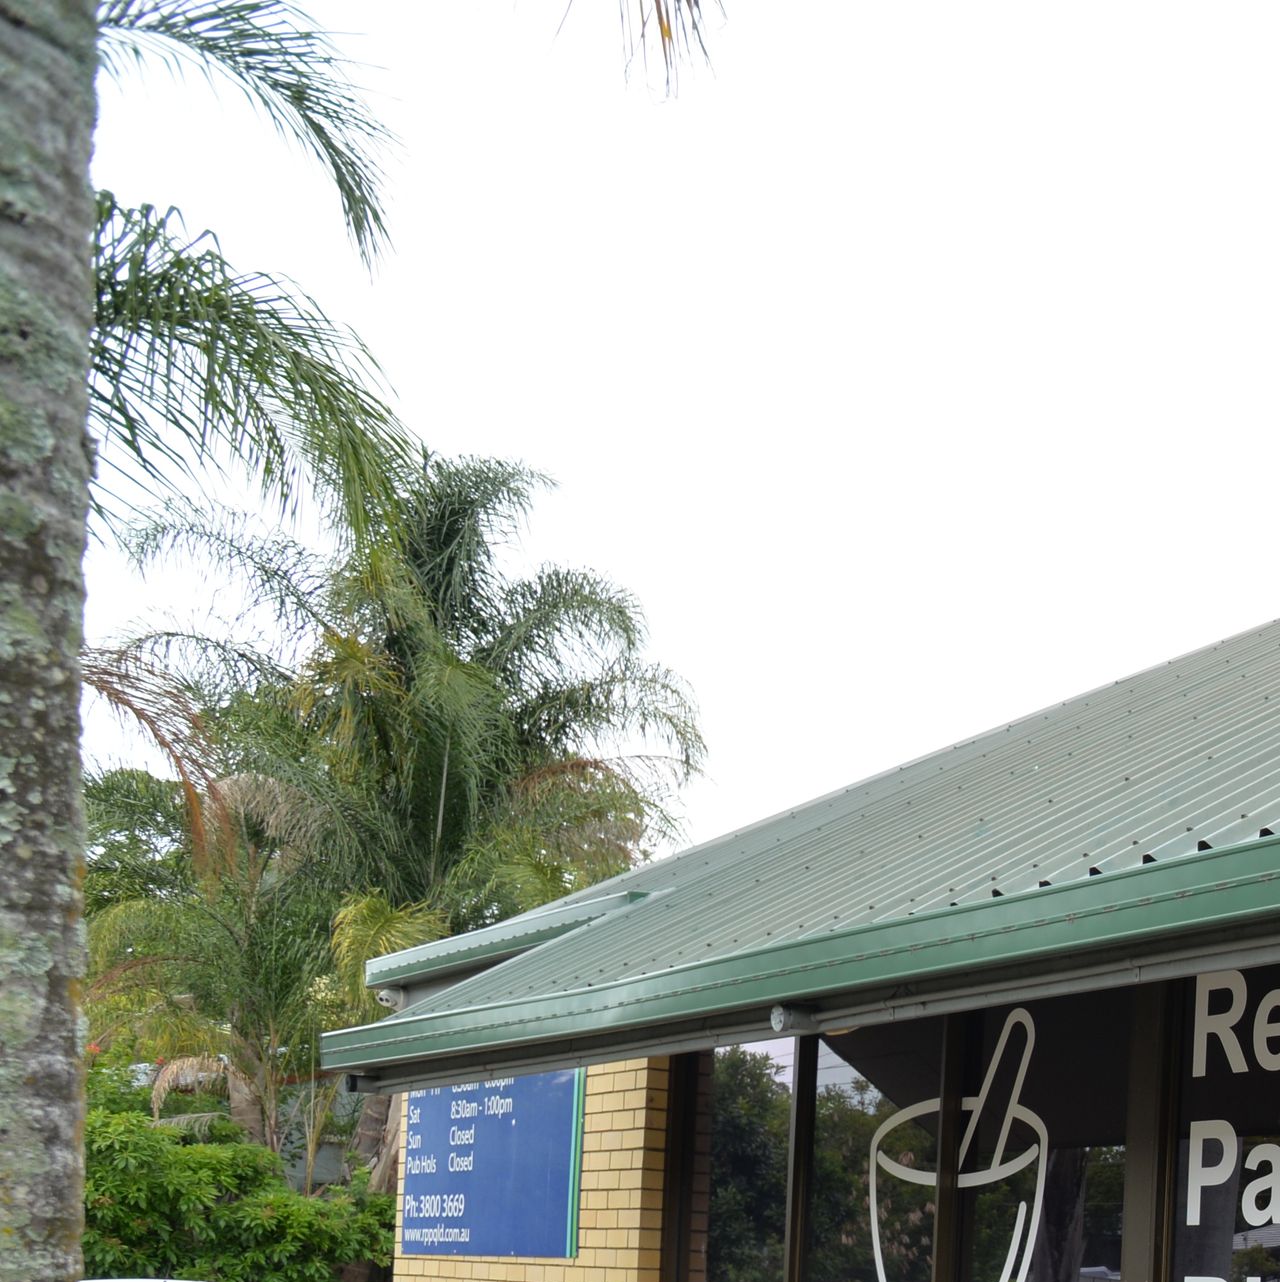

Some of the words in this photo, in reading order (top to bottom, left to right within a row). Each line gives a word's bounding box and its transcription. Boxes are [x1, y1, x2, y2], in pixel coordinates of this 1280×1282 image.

[409, 1106, 420, 1124] Sat
[451, 1099, 478, 1119] 8:30am
[484, 1095, 513, 1119] 1:00pm
[408, 1131, 421, 1149] Sun
[449, 1123, 475, 1146] Closed
[406, 1155, 421, 1175] Pub
[421, 1154, 437, 1174] Hols
[448, 1150, 474, 1172] Closed
[405, 1194, 418, 1218] Ph:
[419, 1194, 441, 1218] 3800
[442, 1193, 465, 1217] 3669
